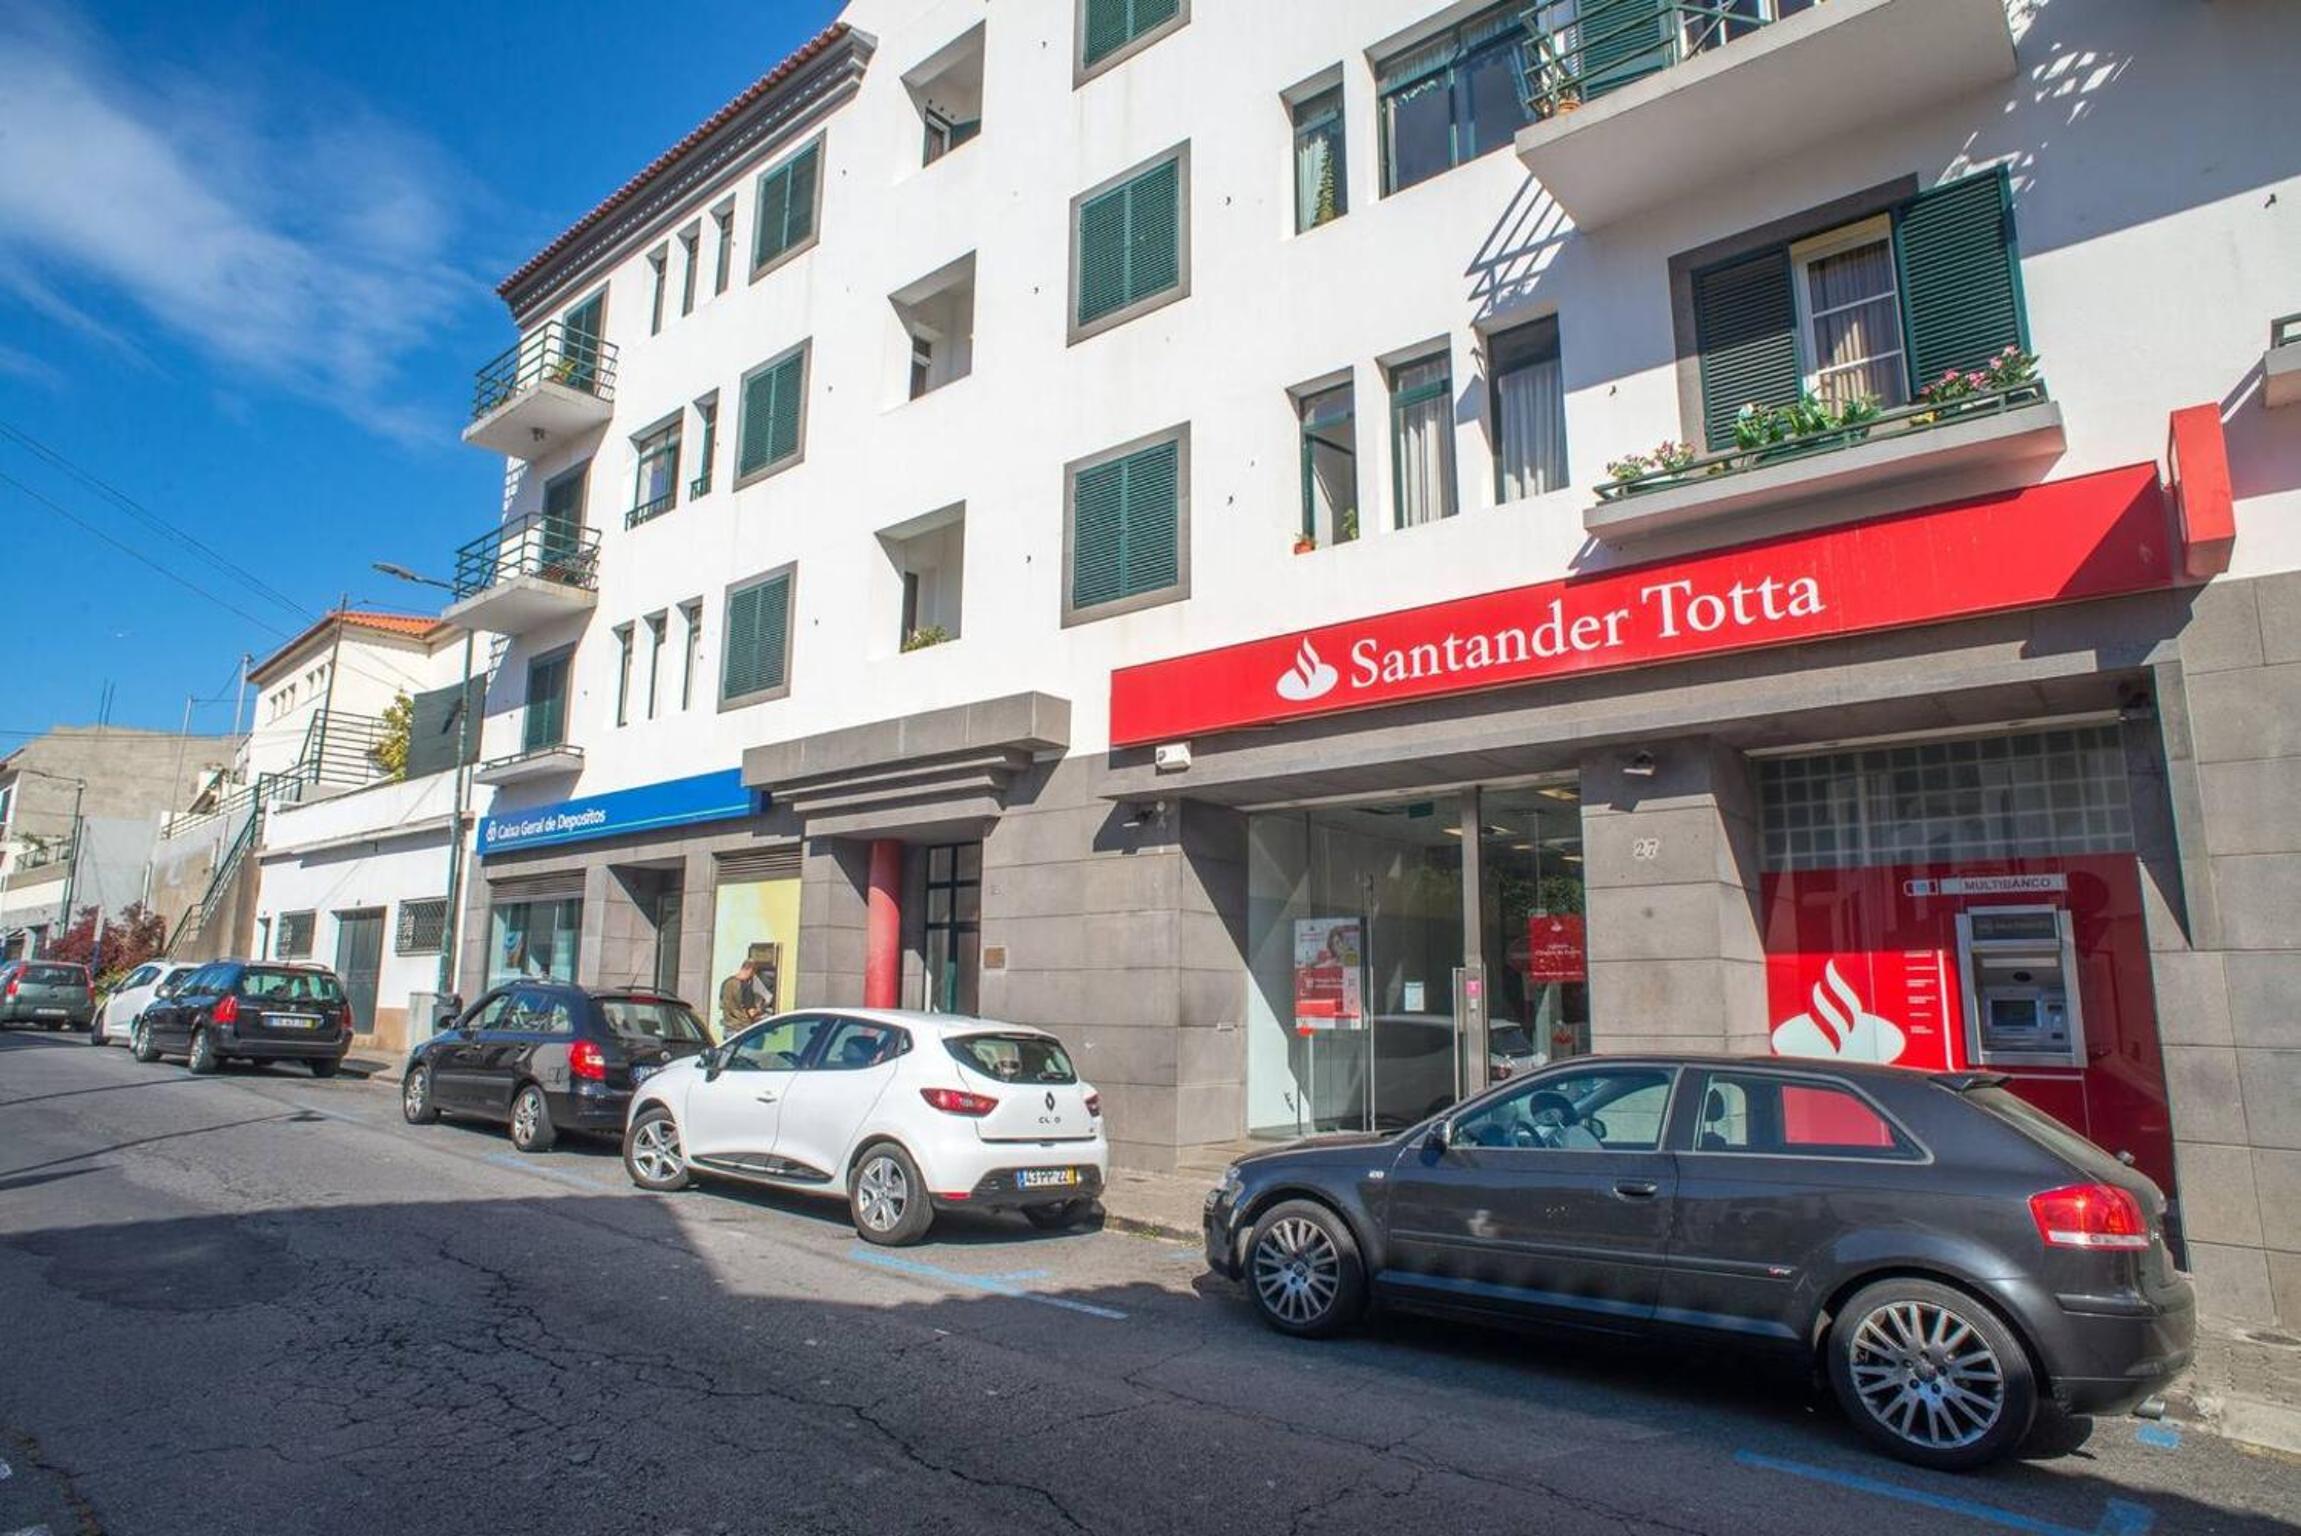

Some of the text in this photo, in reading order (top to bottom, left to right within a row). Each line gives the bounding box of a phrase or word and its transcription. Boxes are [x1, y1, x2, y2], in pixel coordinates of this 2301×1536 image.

[1350, 575, 1827, 689] Santander Totta
[497, 823, 520, 840] Caixa
[521, 817, 543, 836] Geral
[544, 815, 556, 832] de
[1633, 837, 1660, 861] 27
[1964, 877, 2050, 890] MULTIBANCO
